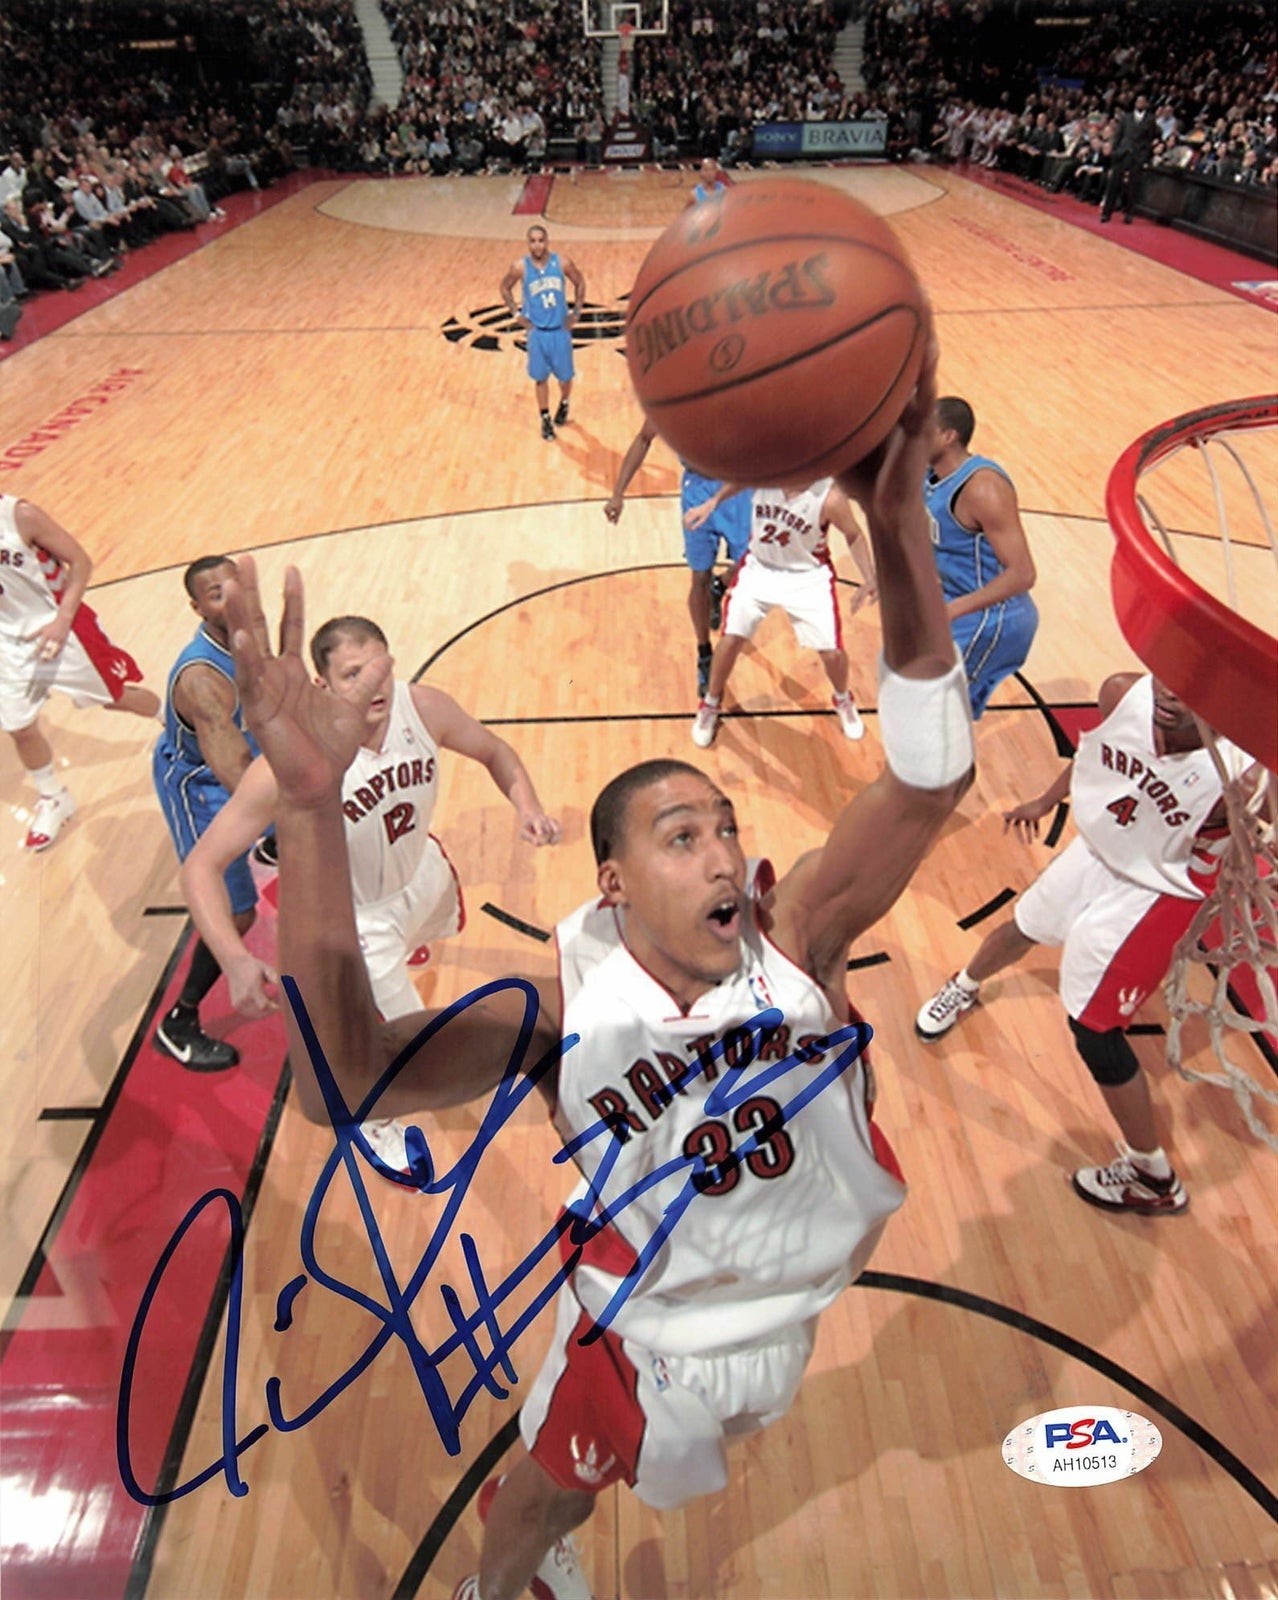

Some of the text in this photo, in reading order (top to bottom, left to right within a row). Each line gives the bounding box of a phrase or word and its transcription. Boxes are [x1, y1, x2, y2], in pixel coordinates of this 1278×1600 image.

[808, 128, 884, 147] BRAVIA
[541, 292, 557, 309] 14
[633, 251, 837, 376] SPALDING
[755, 504, 812, 535] RAPTORS
[760, 523, 791, 548] 24
[342, 757, 435, 824] RAPTORS
[1101, 741, 1191, 828] RAPTORS
[383, 801, 416, 845] 12
[1106, 794, 1139, 828] 4
[587, 1023, 829, 1146] RAPTORS
[682, 1095, 796, 1196] 33
